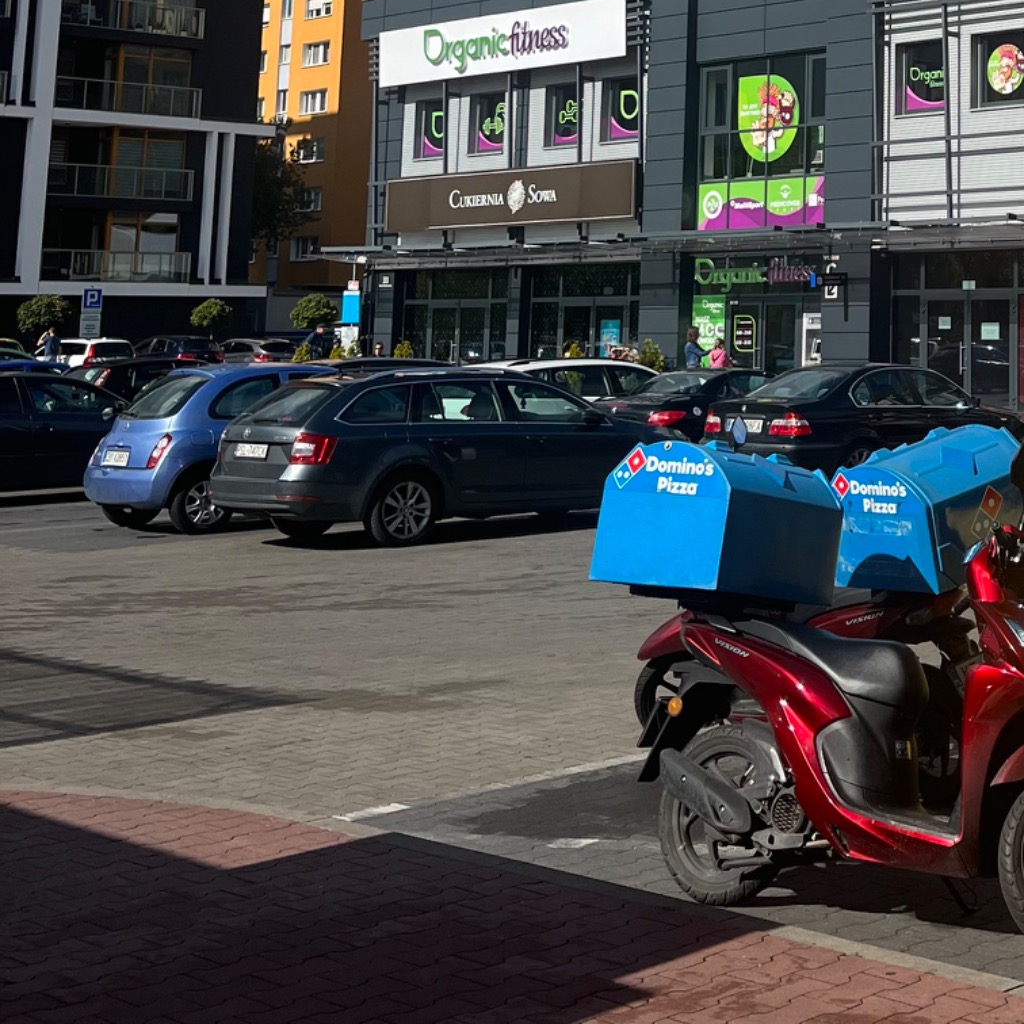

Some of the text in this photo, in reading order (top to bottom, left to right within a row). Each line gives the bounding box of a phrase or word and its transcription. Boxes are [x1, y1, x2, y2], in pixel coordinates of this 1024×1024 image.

[86, 290, 99, 307] P
[645, 456, 714, 476] Domino's
[657, 477, 698, 495] Pizza
[850, 480, 907, 497] Domino's
[863, 498, 898, 514] Pizza
[714, 637, 750, 658] VISION
